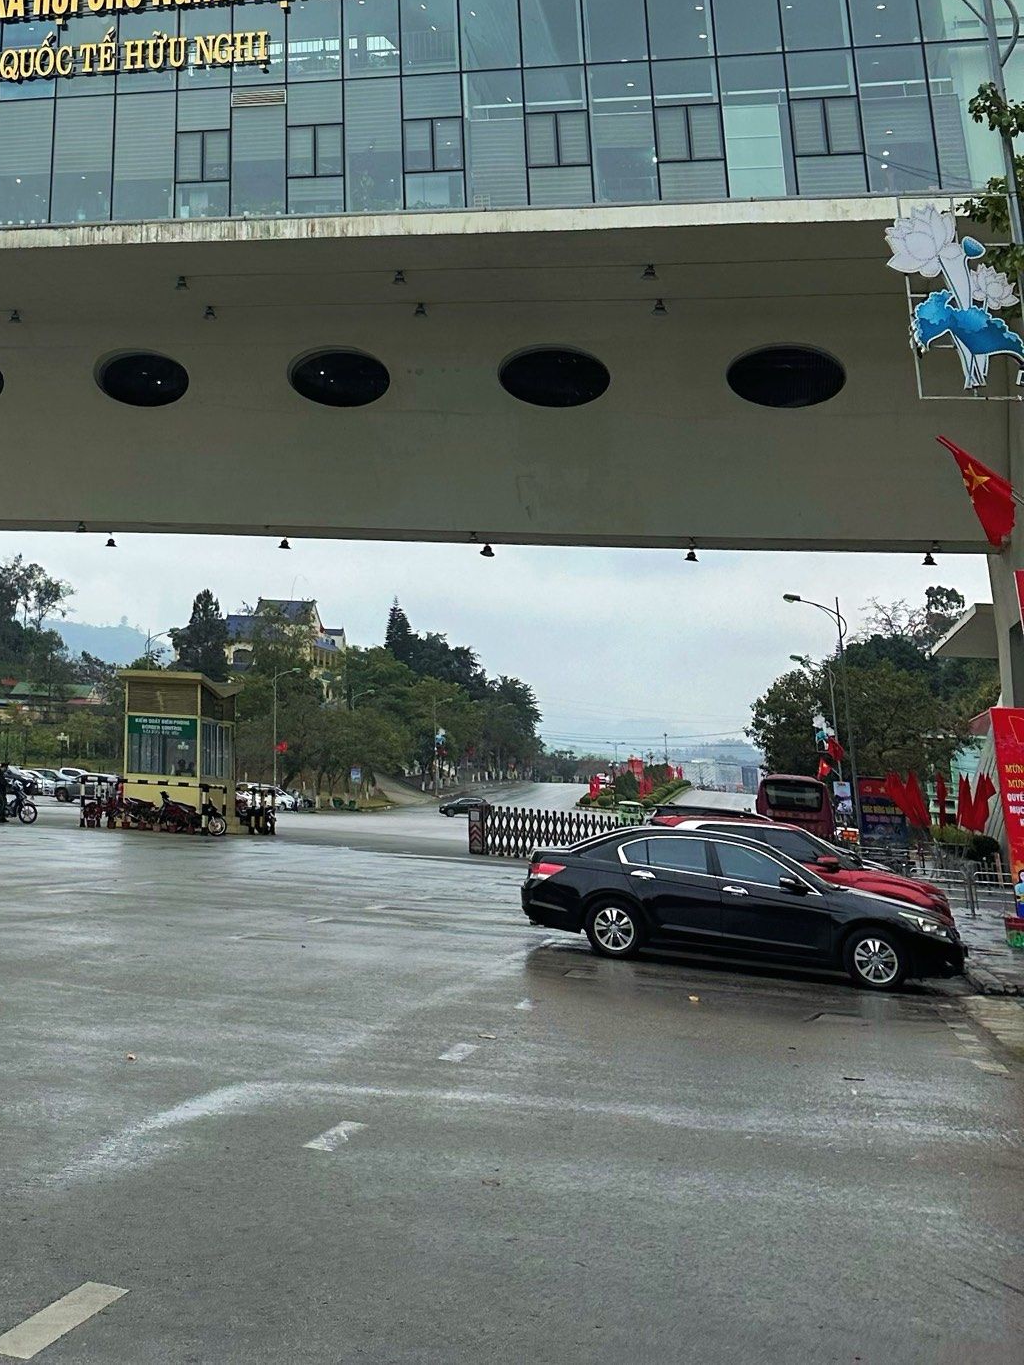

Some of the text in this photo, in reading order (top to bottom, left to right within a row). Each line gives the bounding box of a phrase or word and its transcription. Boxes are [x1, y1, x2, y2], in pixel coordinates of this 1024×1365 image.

[0, 31, 73, 80] QUỐC
[80, 26, 116, 73] TẾ
[123, 30, 187, 69] HỮU
[194, 31, 268, 69] NGHỊ
